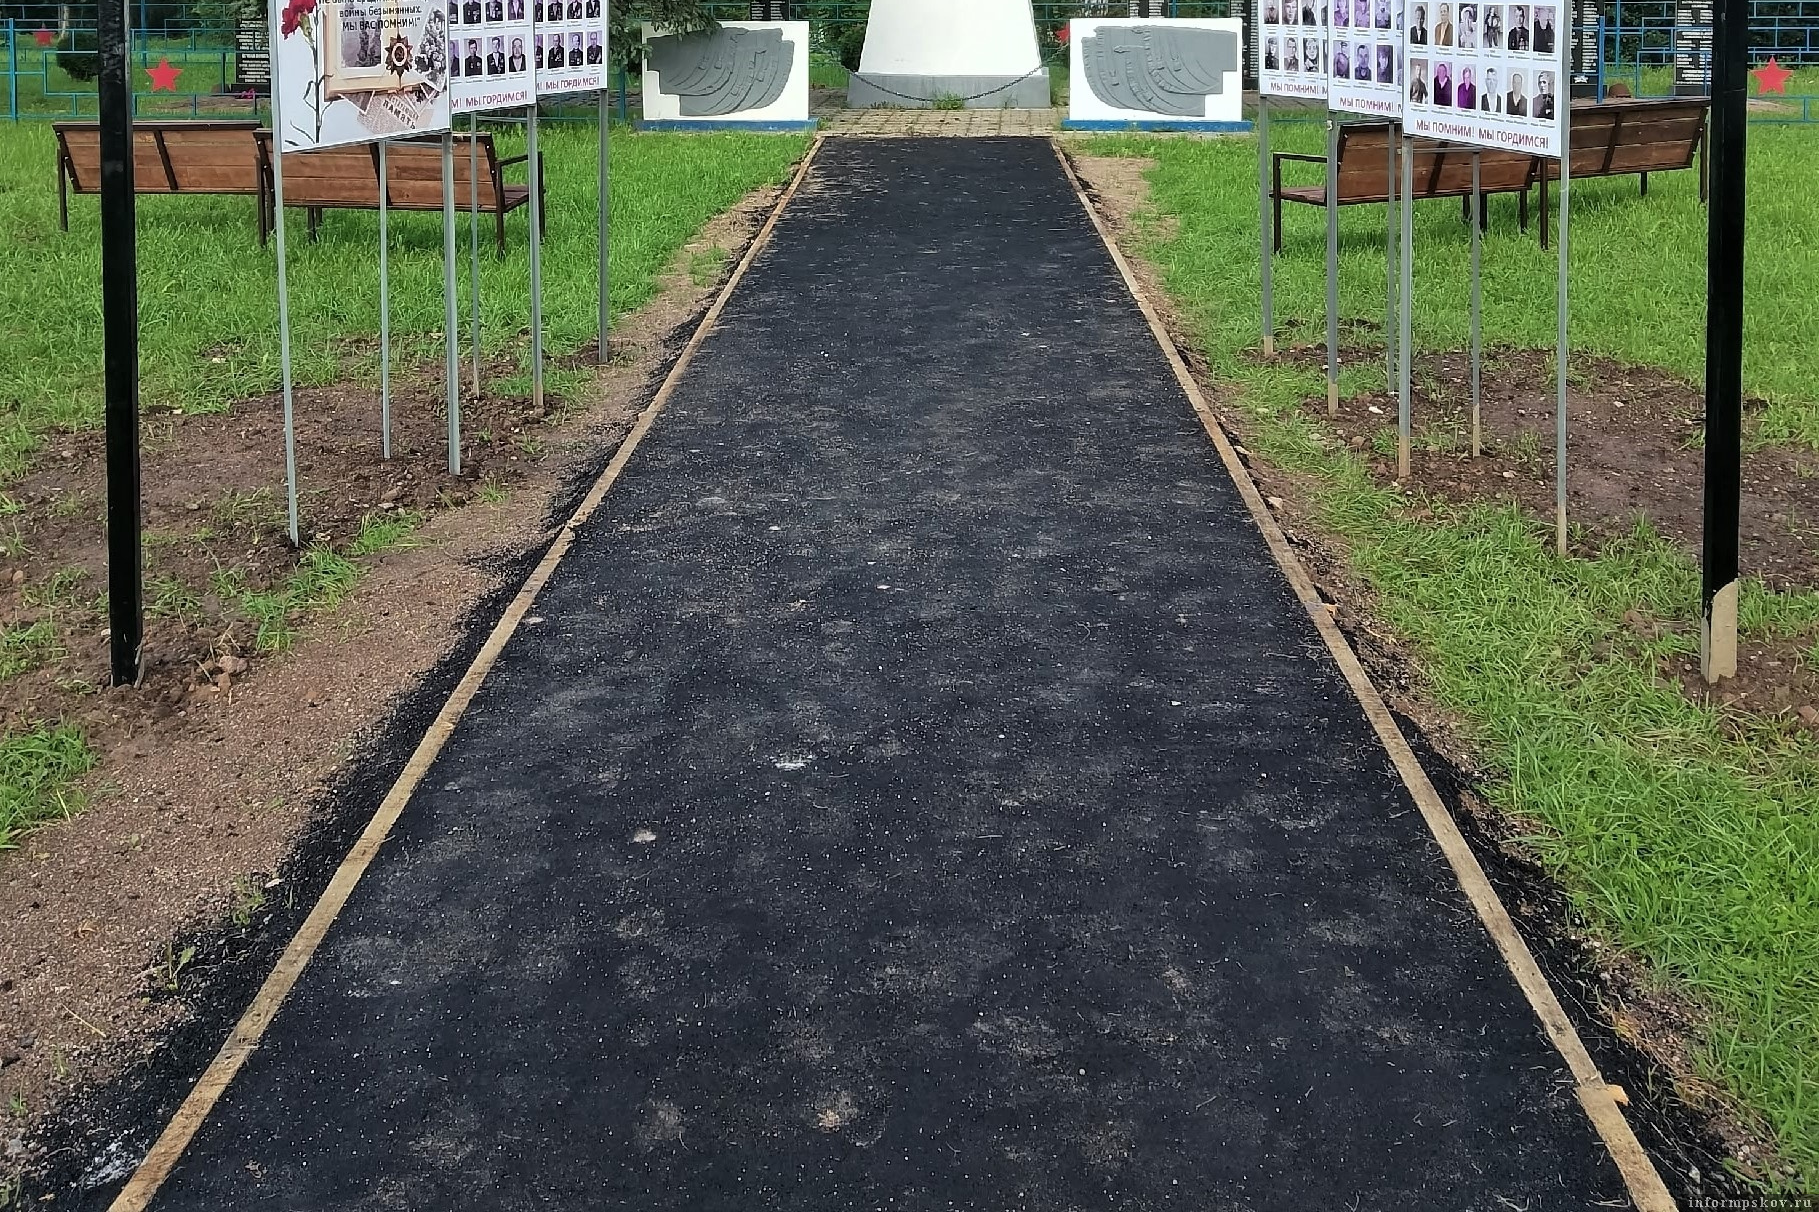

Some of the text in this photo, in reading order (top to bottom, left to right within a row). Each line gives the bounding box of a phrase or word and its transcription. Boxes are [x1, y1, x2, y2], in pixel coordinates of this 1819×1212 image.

[339, 8, 367, 18] войны
[342, 20, 358, 32] МЫ
[359, 19, 377, 31] ВАС
[545, 81, 559, 90] МЫ
[560, 76, 600, 89] ГОРДИМСЯ!
[1270, 82, 1283, 92] МЫ
[1283, 83, 1319, 95] ПОМНИМ!
[465, 95, 481, 107] МЫ
[482, 90, 528, 106] ГОРДИМСЯ!
[1339, 97, 1354, 107] МЫ
[1355, 99, 1394, 113] ПОМНИМ!
[1416, 119, 1549, 149] МЫ ПОМНИМ! МЫ ГОРДИМСЯ!
